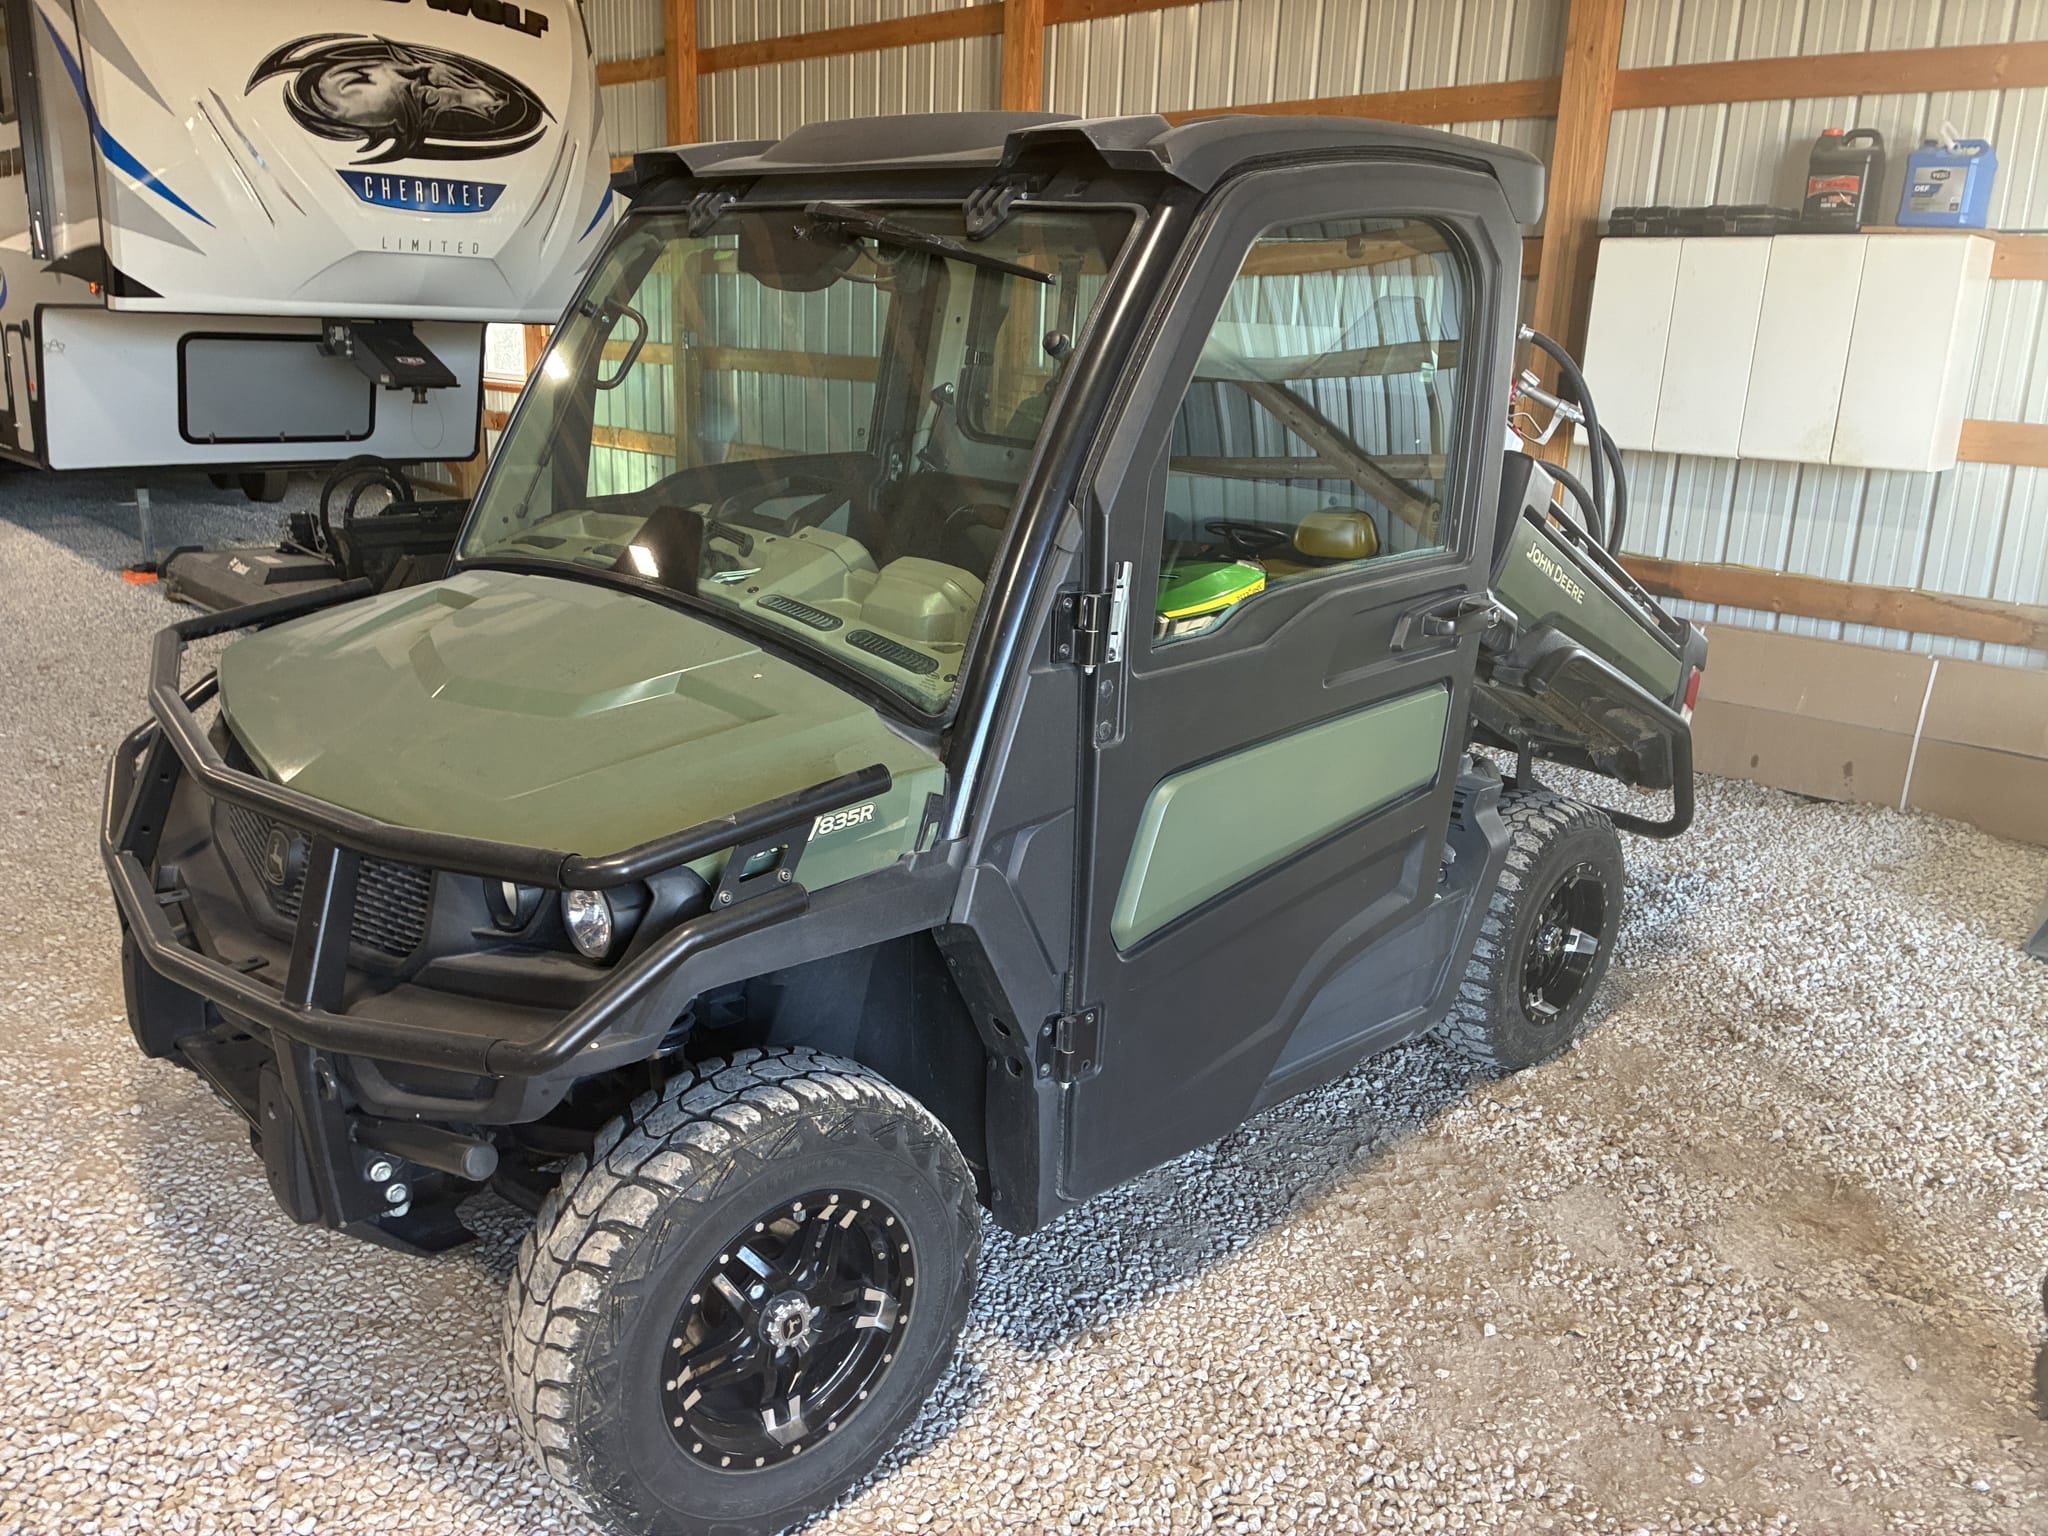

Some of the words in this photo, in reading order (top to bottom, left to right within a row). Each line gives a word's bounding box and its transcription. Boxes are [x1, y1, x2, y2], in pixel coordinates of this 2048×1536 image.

[364, 176, 485, 208] CHEROKEE
[382, 236, 480, 255] LIMITED
[1526, 542, 1555, 577] JOHN
[1553, 564, 1585, 605] DEERE
